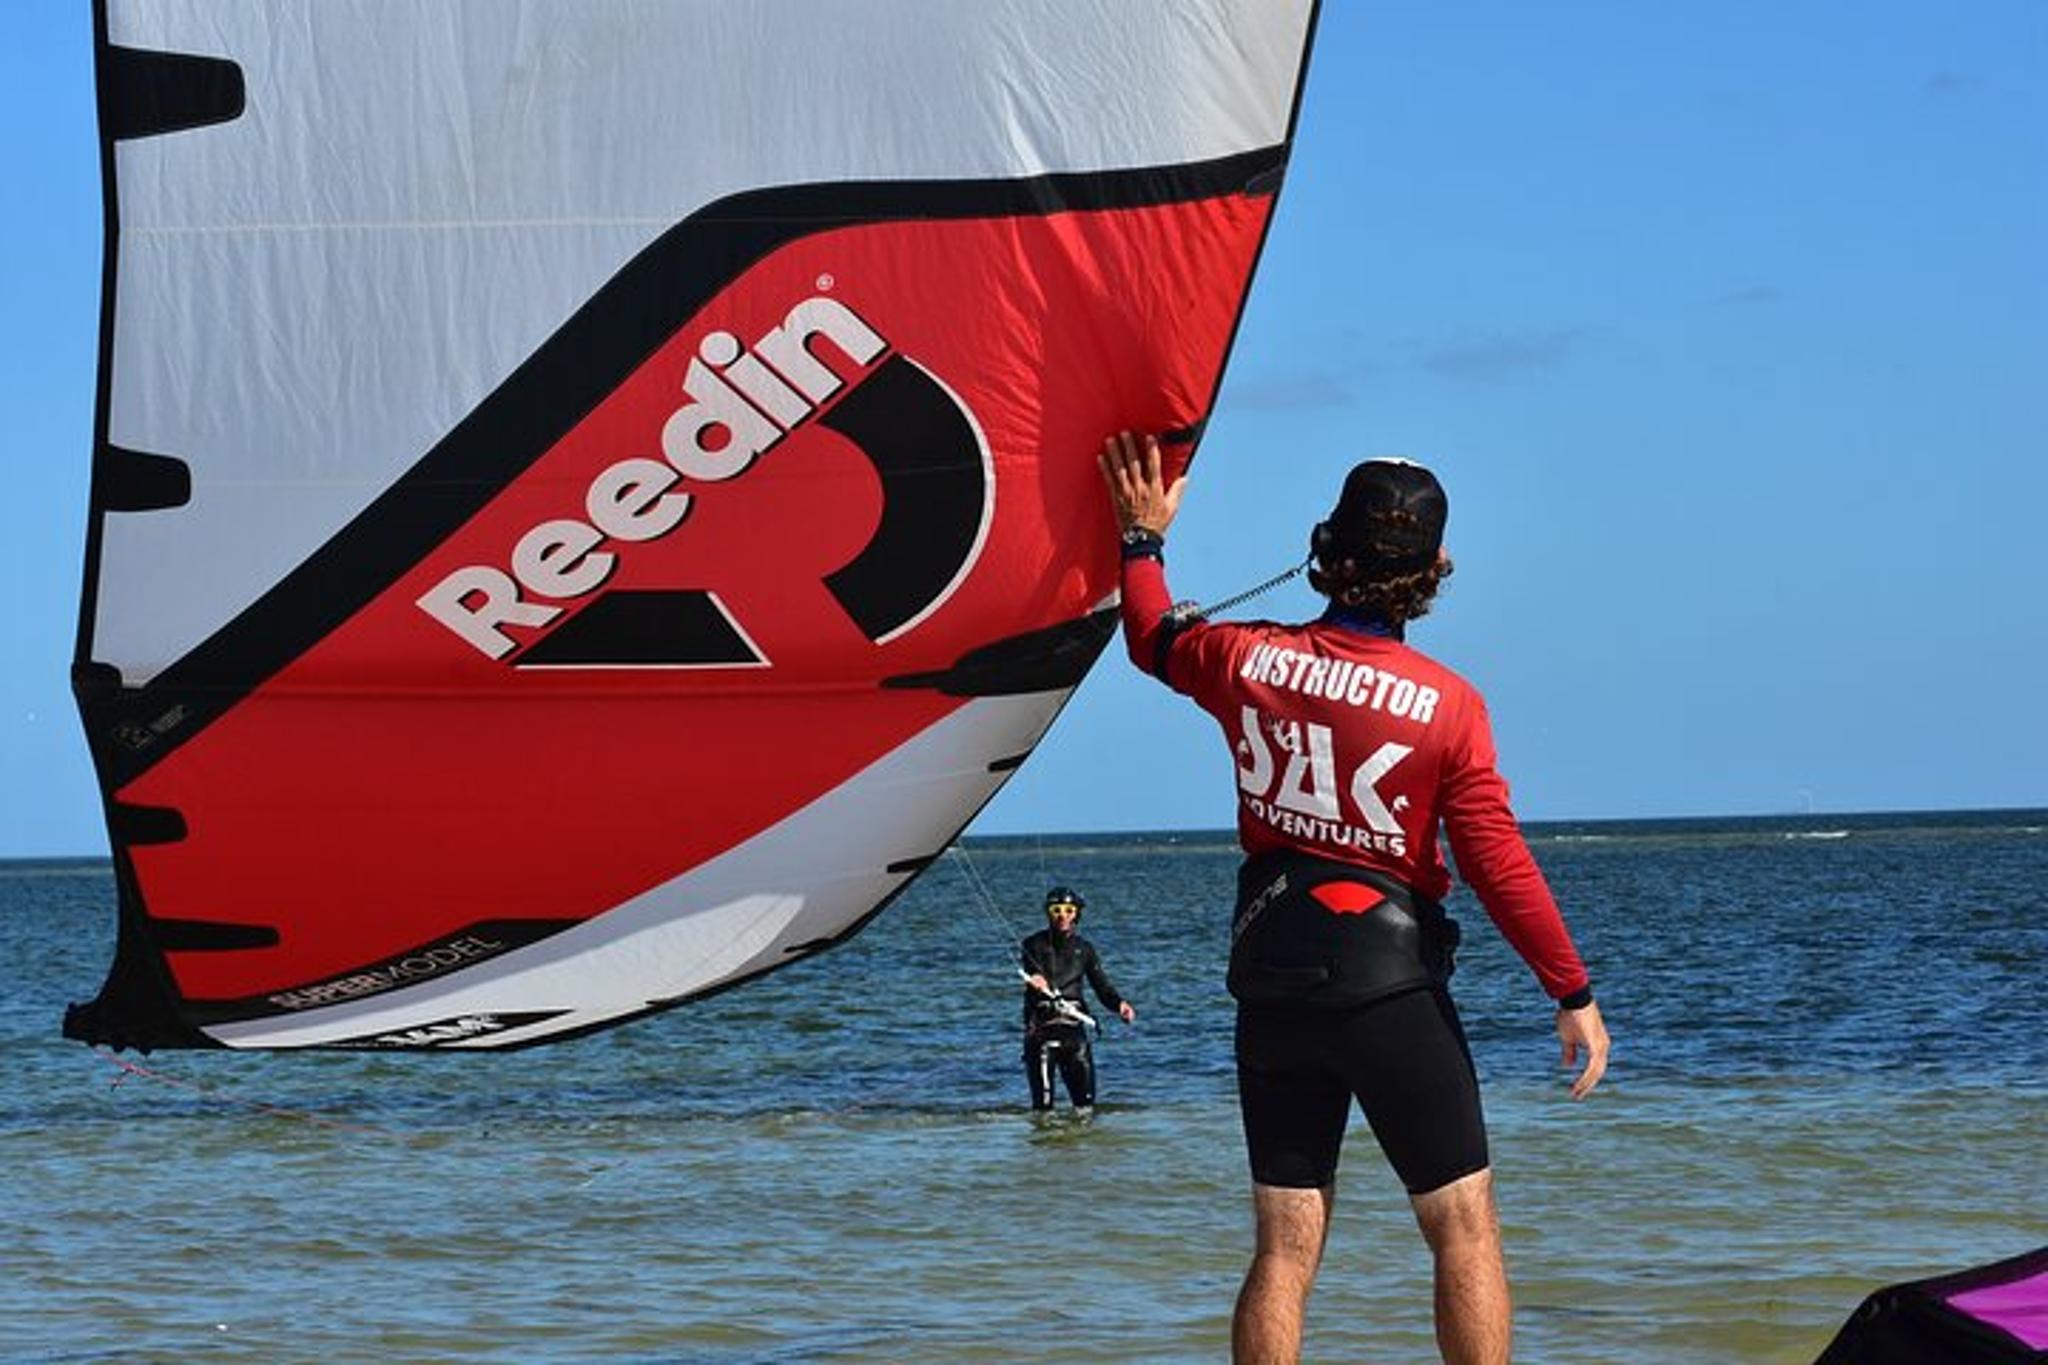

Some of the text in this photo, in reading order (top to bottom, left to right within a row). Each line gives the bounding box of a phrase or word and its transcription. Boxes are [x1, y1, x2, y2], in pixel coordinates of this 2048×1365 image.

[416, 297, 889, 661] Reedin
[1240, 643, 1440, 724] INSTRUCTOR
[1244, 797, 1407, 857] DVENTURES
